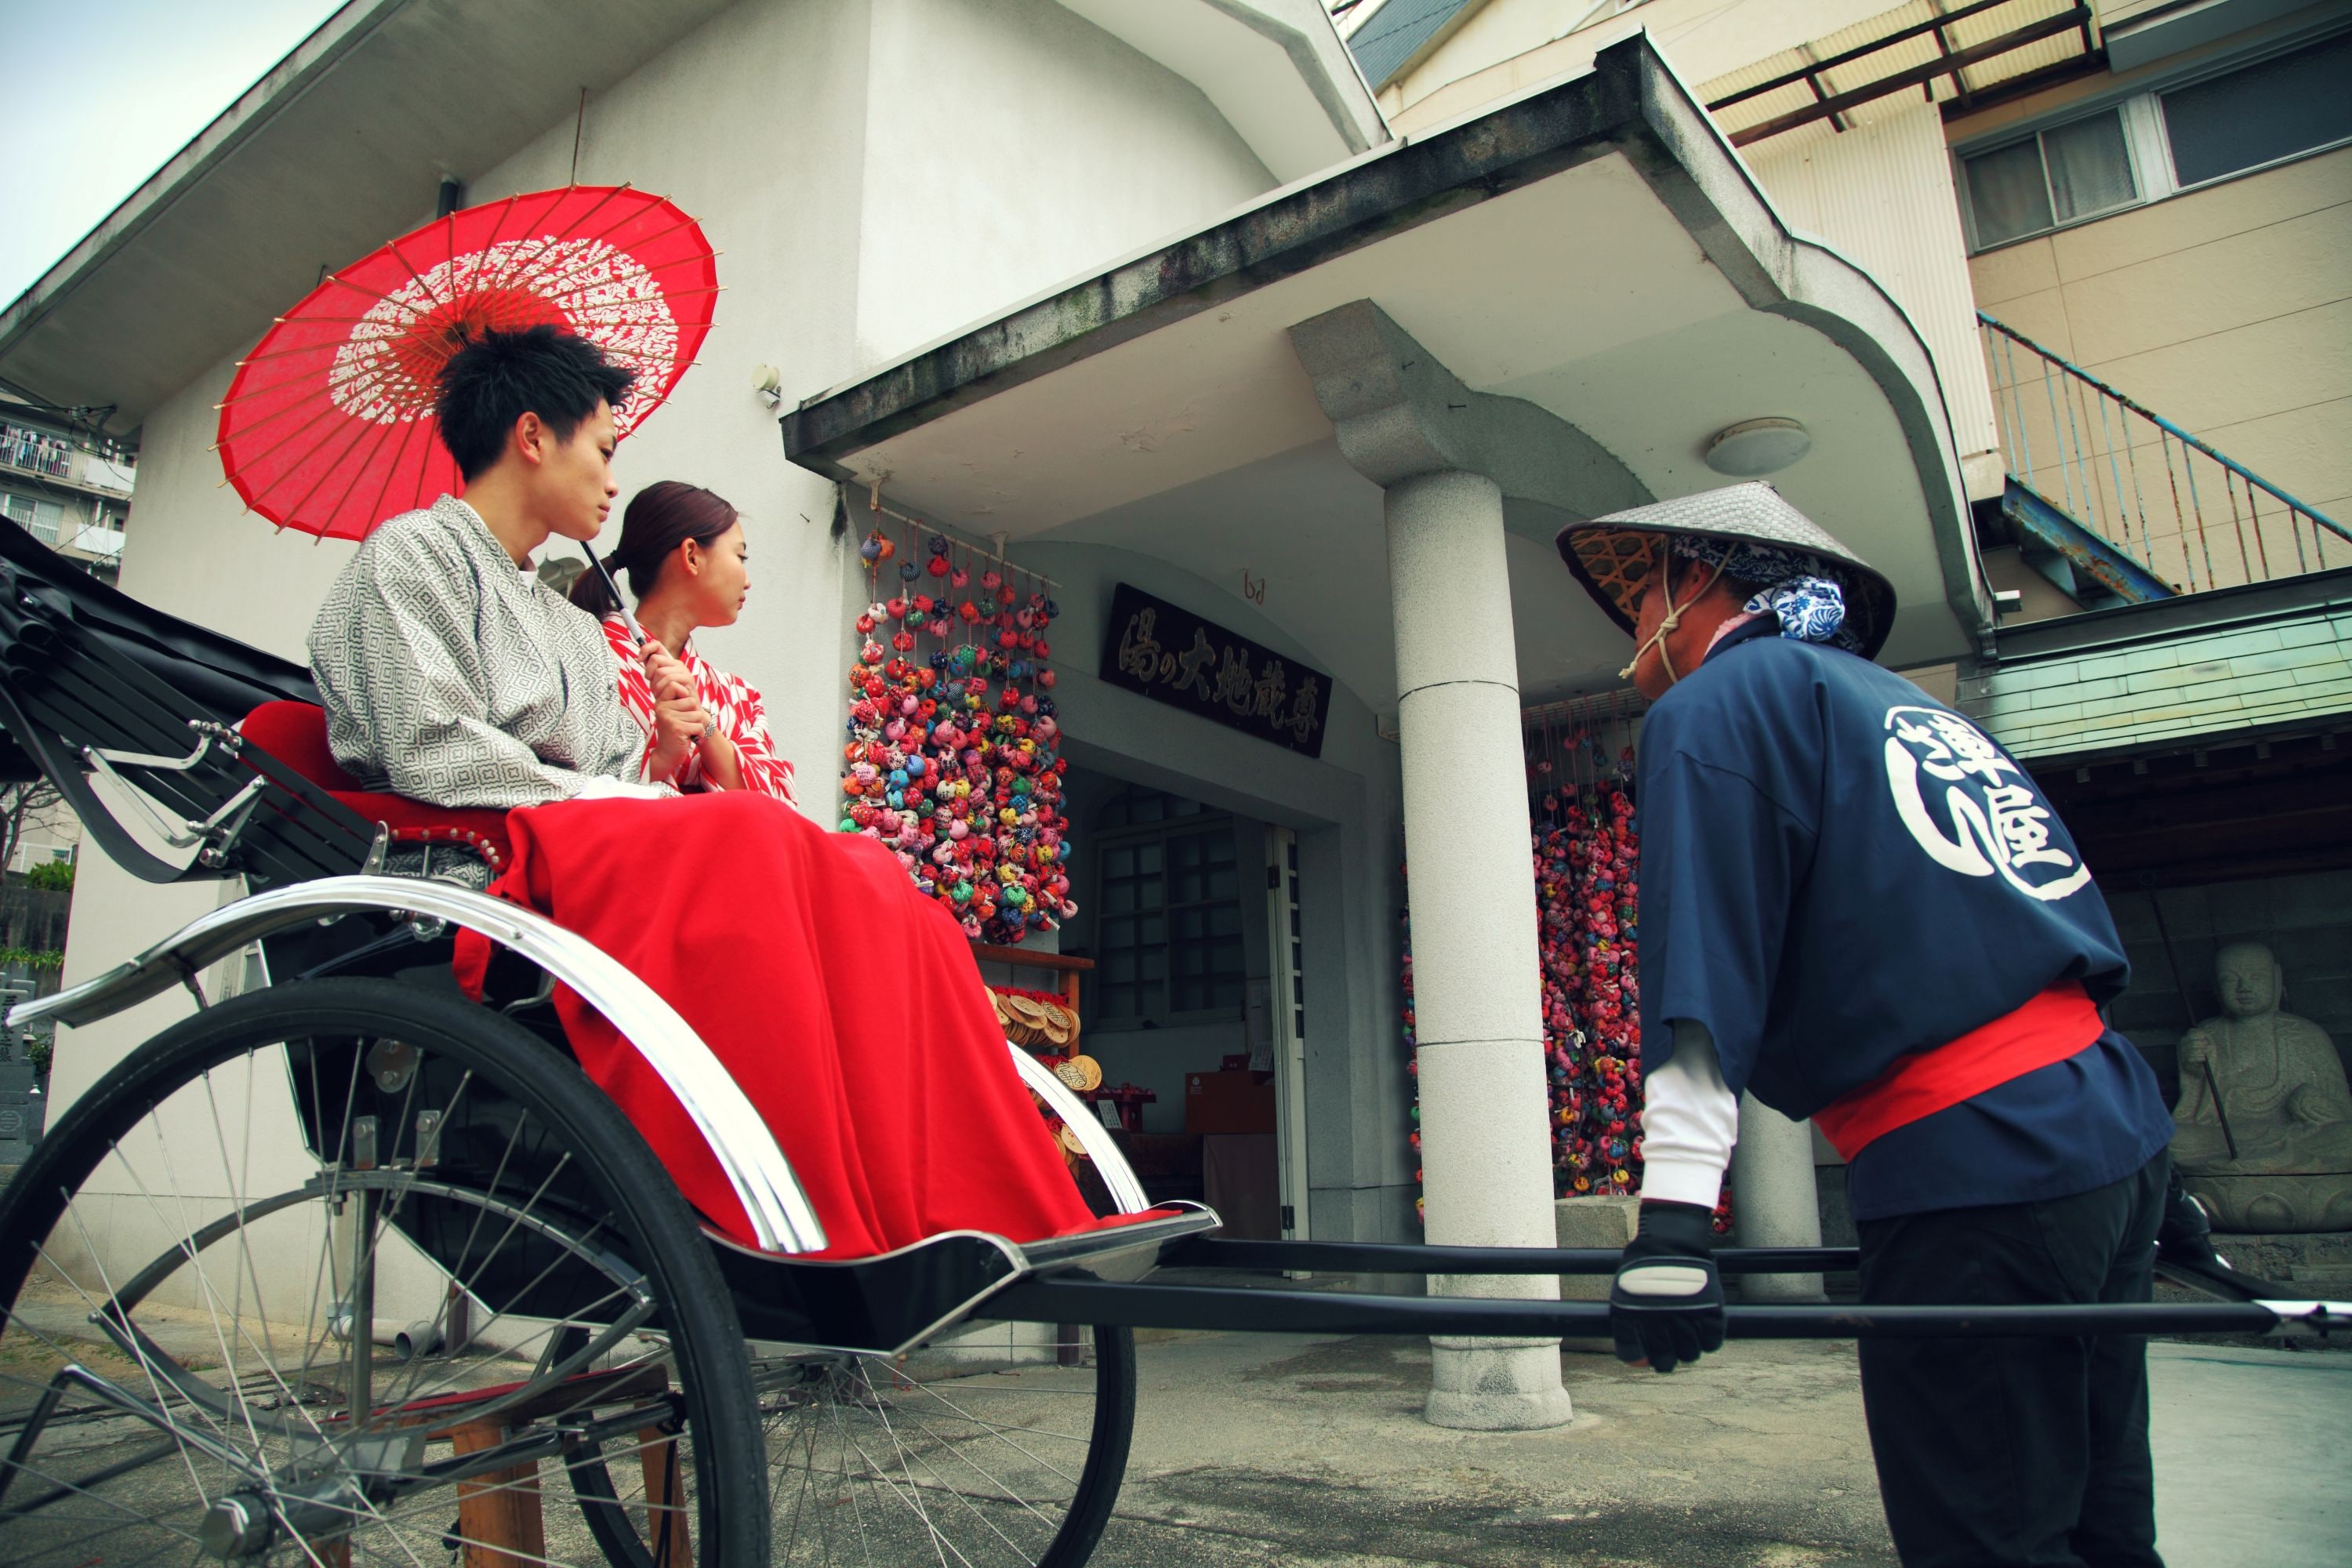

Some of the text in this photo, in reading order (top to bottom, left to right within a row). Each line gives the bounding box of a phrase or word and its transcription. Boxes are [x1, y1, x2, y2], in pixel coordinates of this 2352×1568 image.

[1119, 607, 1319, 743] 湯の大地蔵尊
